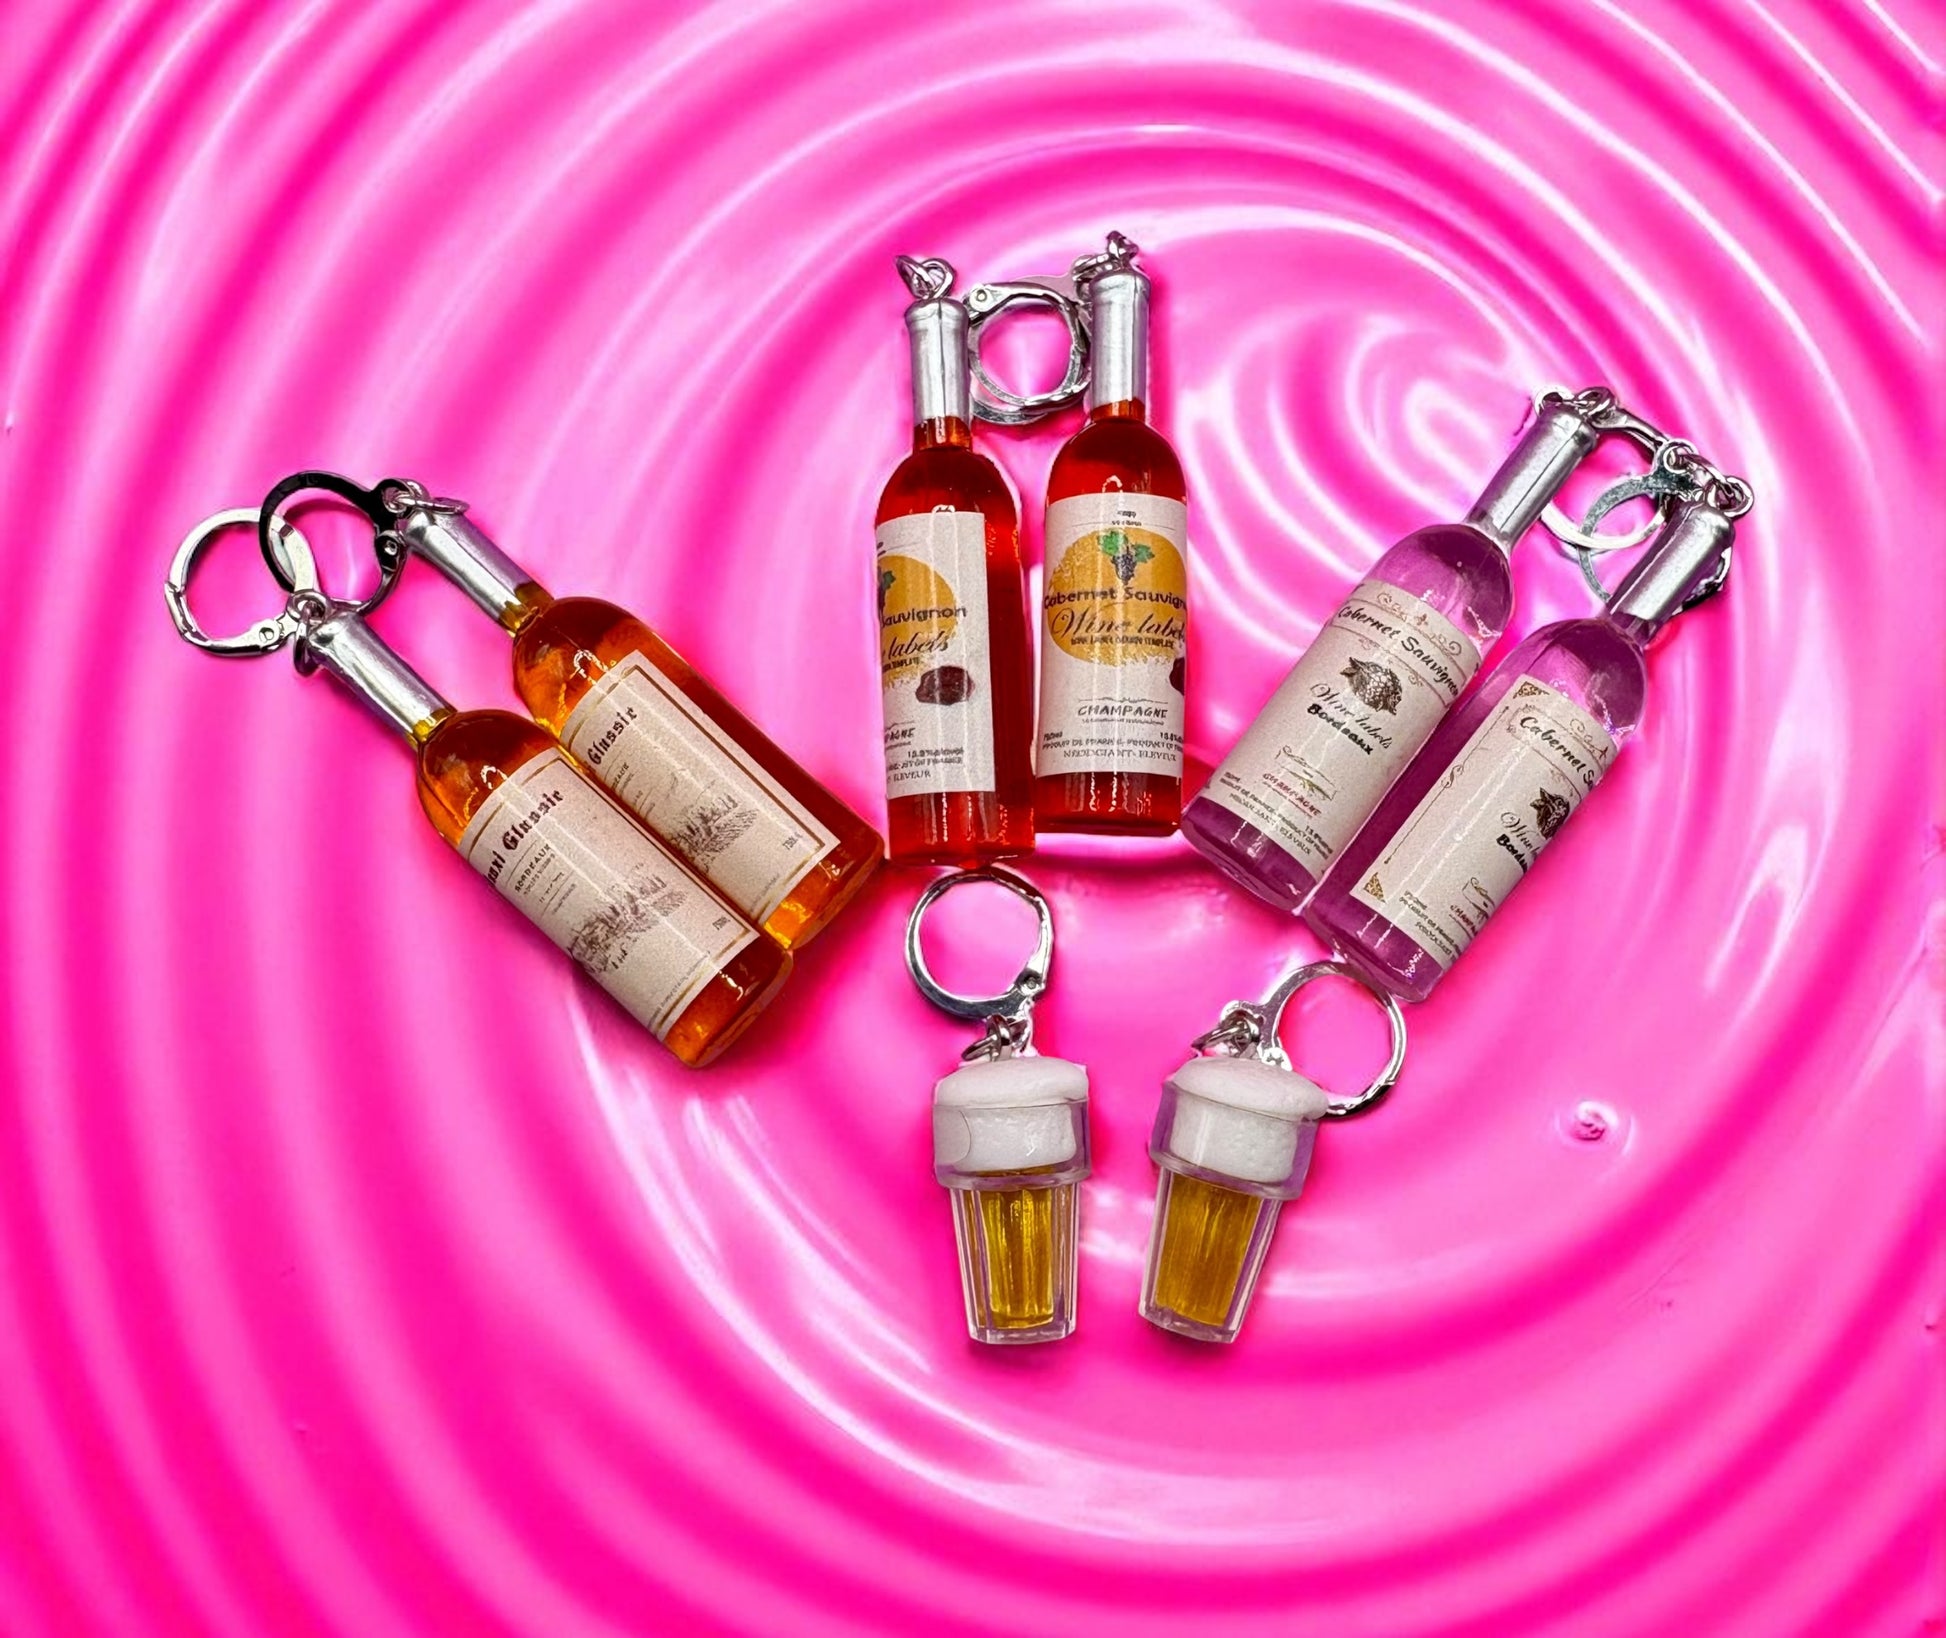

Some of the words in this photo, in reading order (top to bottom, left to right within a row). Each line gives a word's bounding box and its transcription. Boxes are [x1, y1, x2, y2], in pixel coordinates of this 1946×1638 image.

[1338, 606, 1401, 639] Cabernet
[1077, 705, 1168, 719] CHAMPAGNE
[1519, 716, 1587, 773] Cabernet
